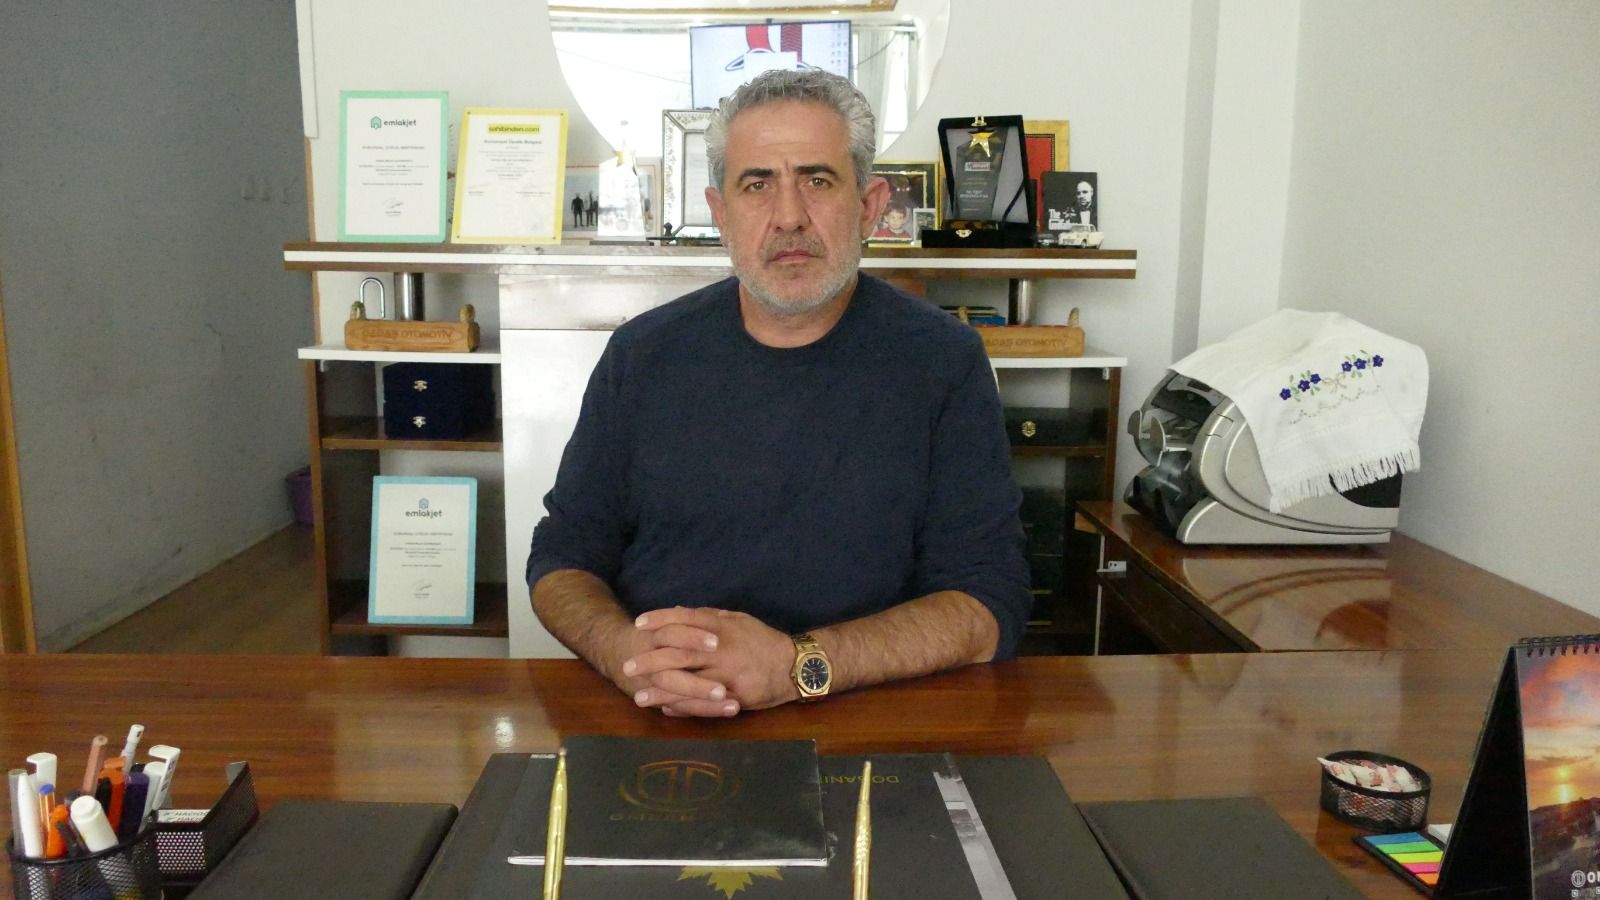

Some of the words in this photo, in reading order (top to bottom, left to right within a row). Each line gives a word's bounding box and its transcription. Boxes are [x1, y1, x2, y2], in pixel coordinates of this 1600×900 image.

[383, 118, 417, 127] emlakjet
[1048, 208, 1061, 219] The
[404, 509, 443, 519] emlakjet
